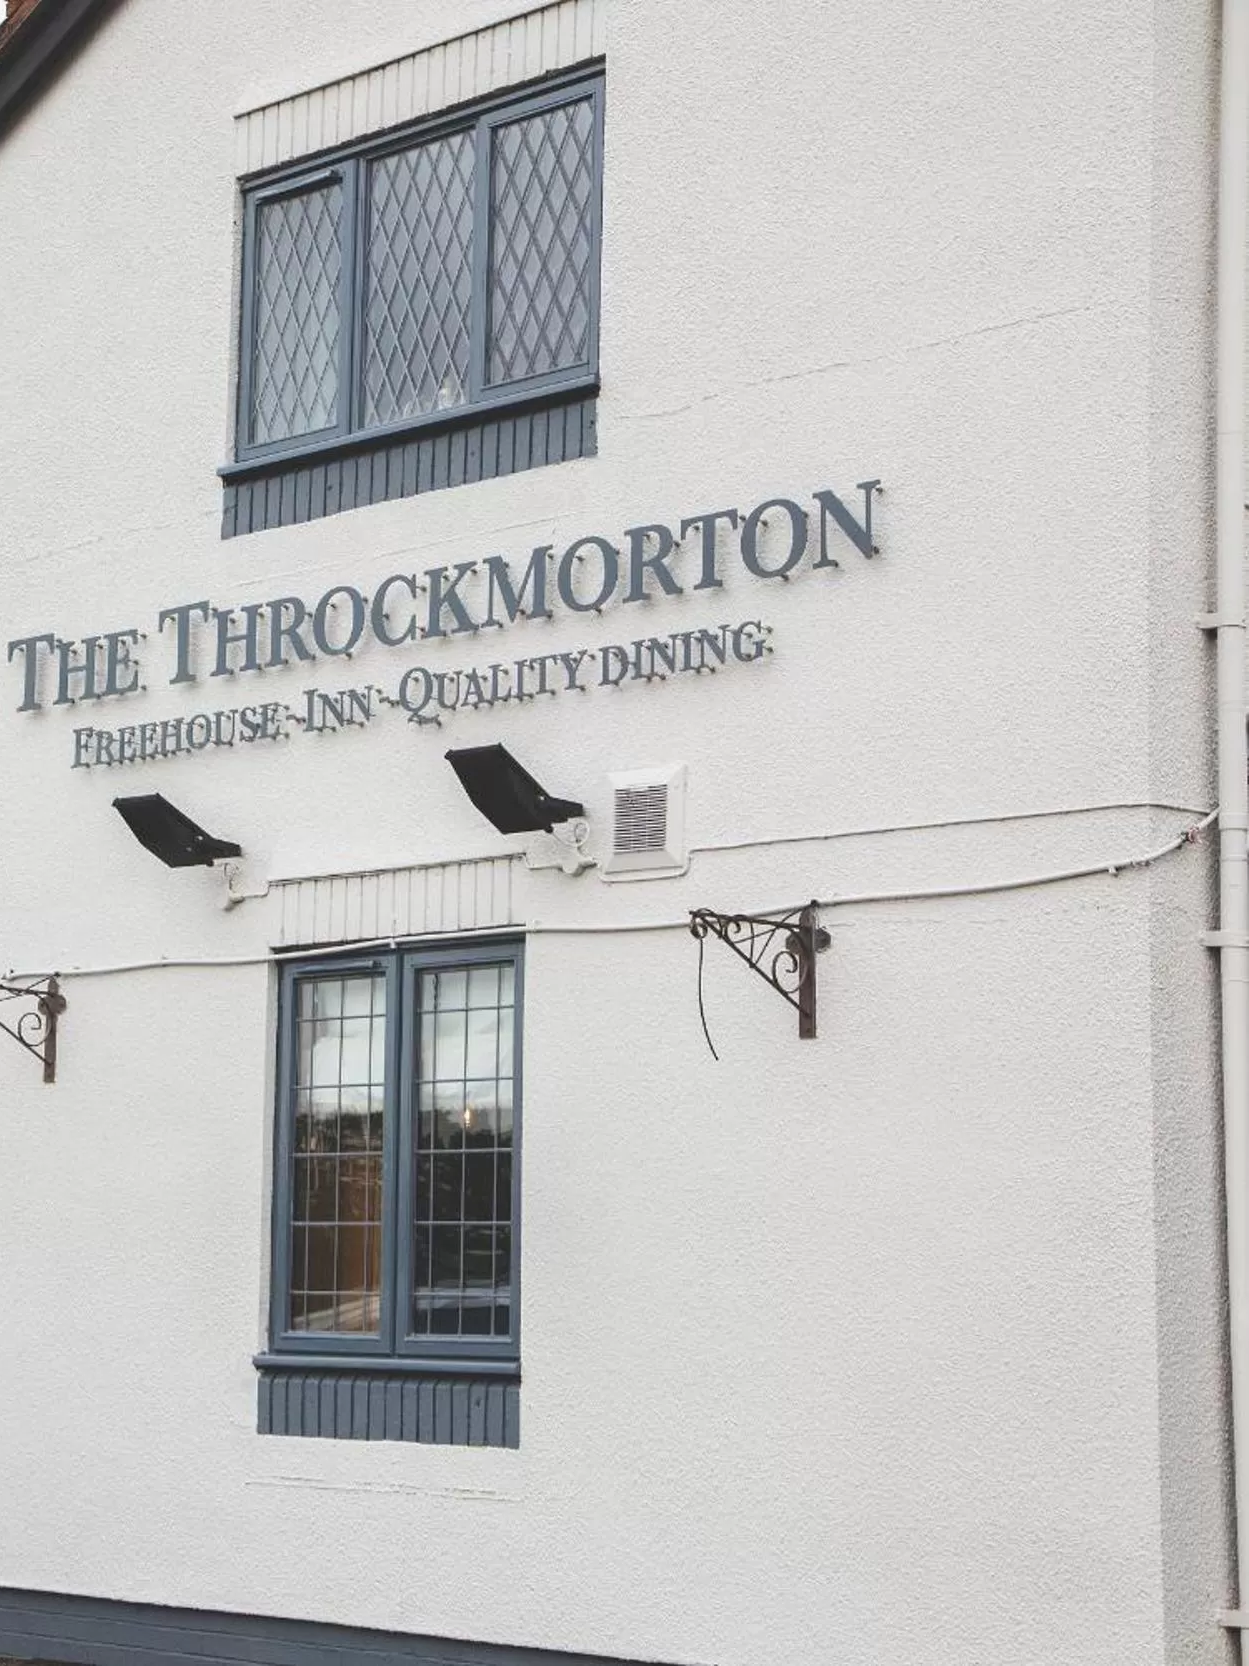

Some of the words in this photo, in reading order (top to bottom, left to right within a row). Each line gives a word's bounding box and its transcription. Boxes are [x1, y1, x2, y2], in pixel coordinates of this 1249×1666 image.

[8, 629, 139, 712] THE
[158, 480, 881, 684] THROCKMORTON
[598, 620, 767, 687] DINING
